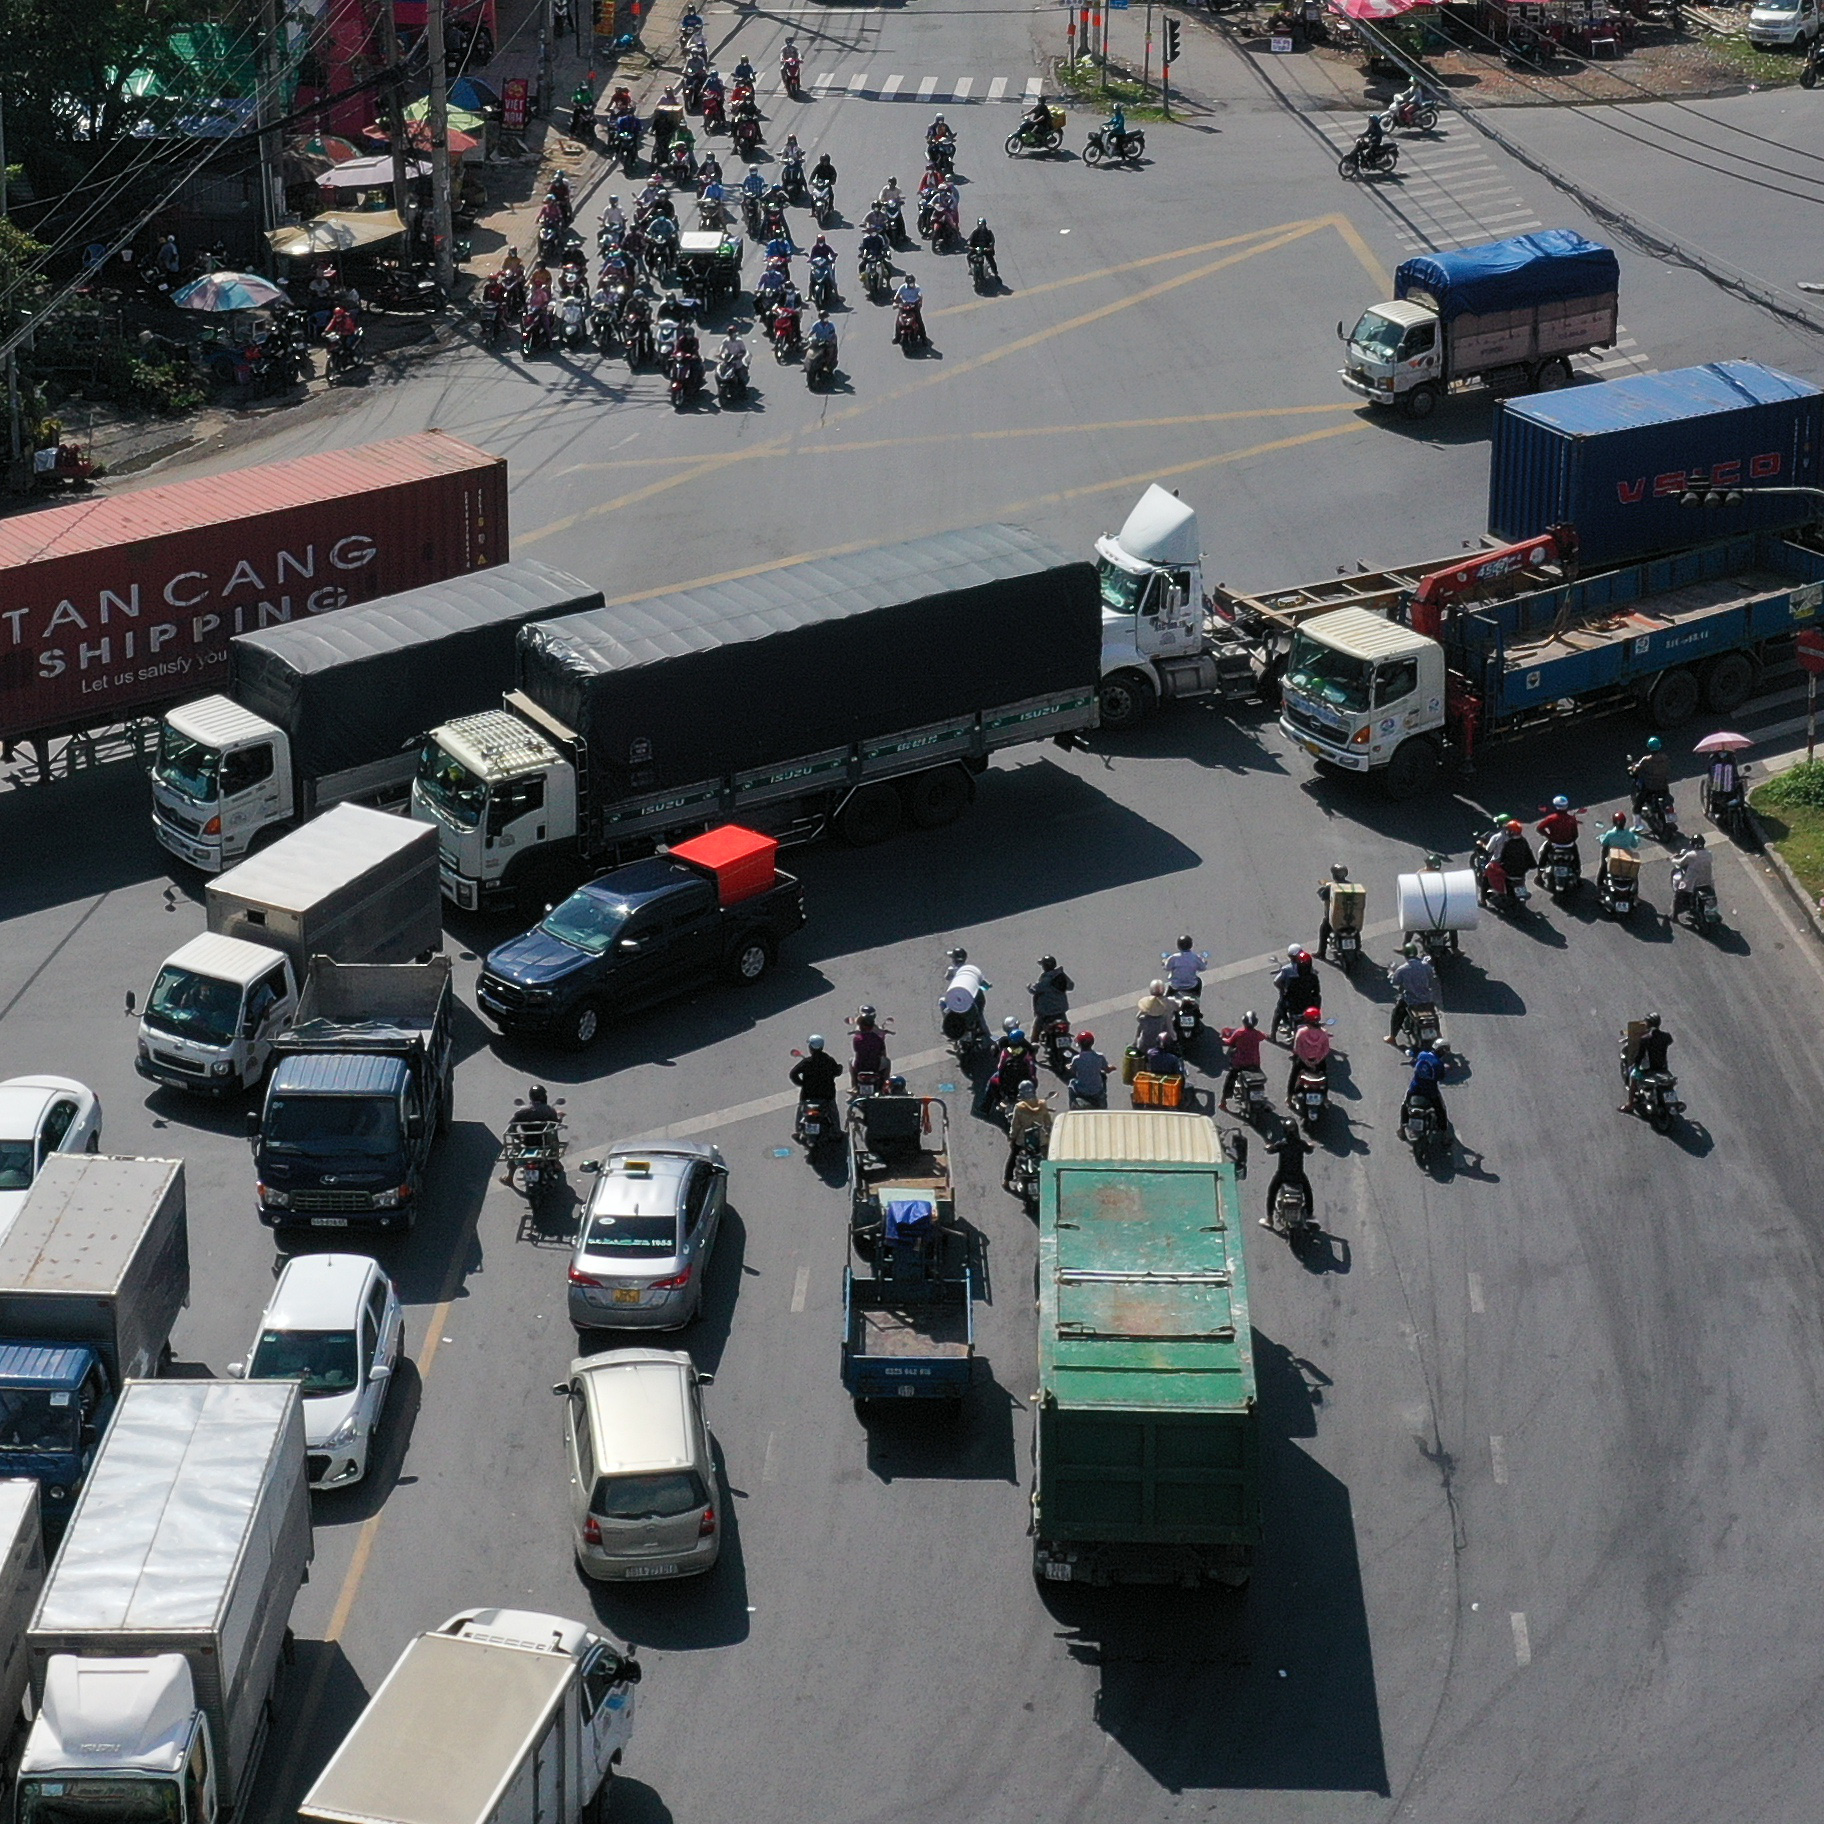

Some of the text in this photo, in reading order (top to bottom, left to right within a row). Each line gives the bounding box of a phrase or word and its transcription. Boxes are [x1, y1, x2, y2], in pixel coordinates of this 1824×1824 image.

[1617, 452, 1781, 504] VSCO
[39, 586, 348, 678] SHIPPING
[82, 675, 109, 694] Let
[114, 669, 135, 685] us
[137, 656, 193, 682] satisfy
[1020, 704, 1060, 722] ISUZU
[770, 766, 813, 784] ISUZU
[641, 797, 685, 816] ISUZU
